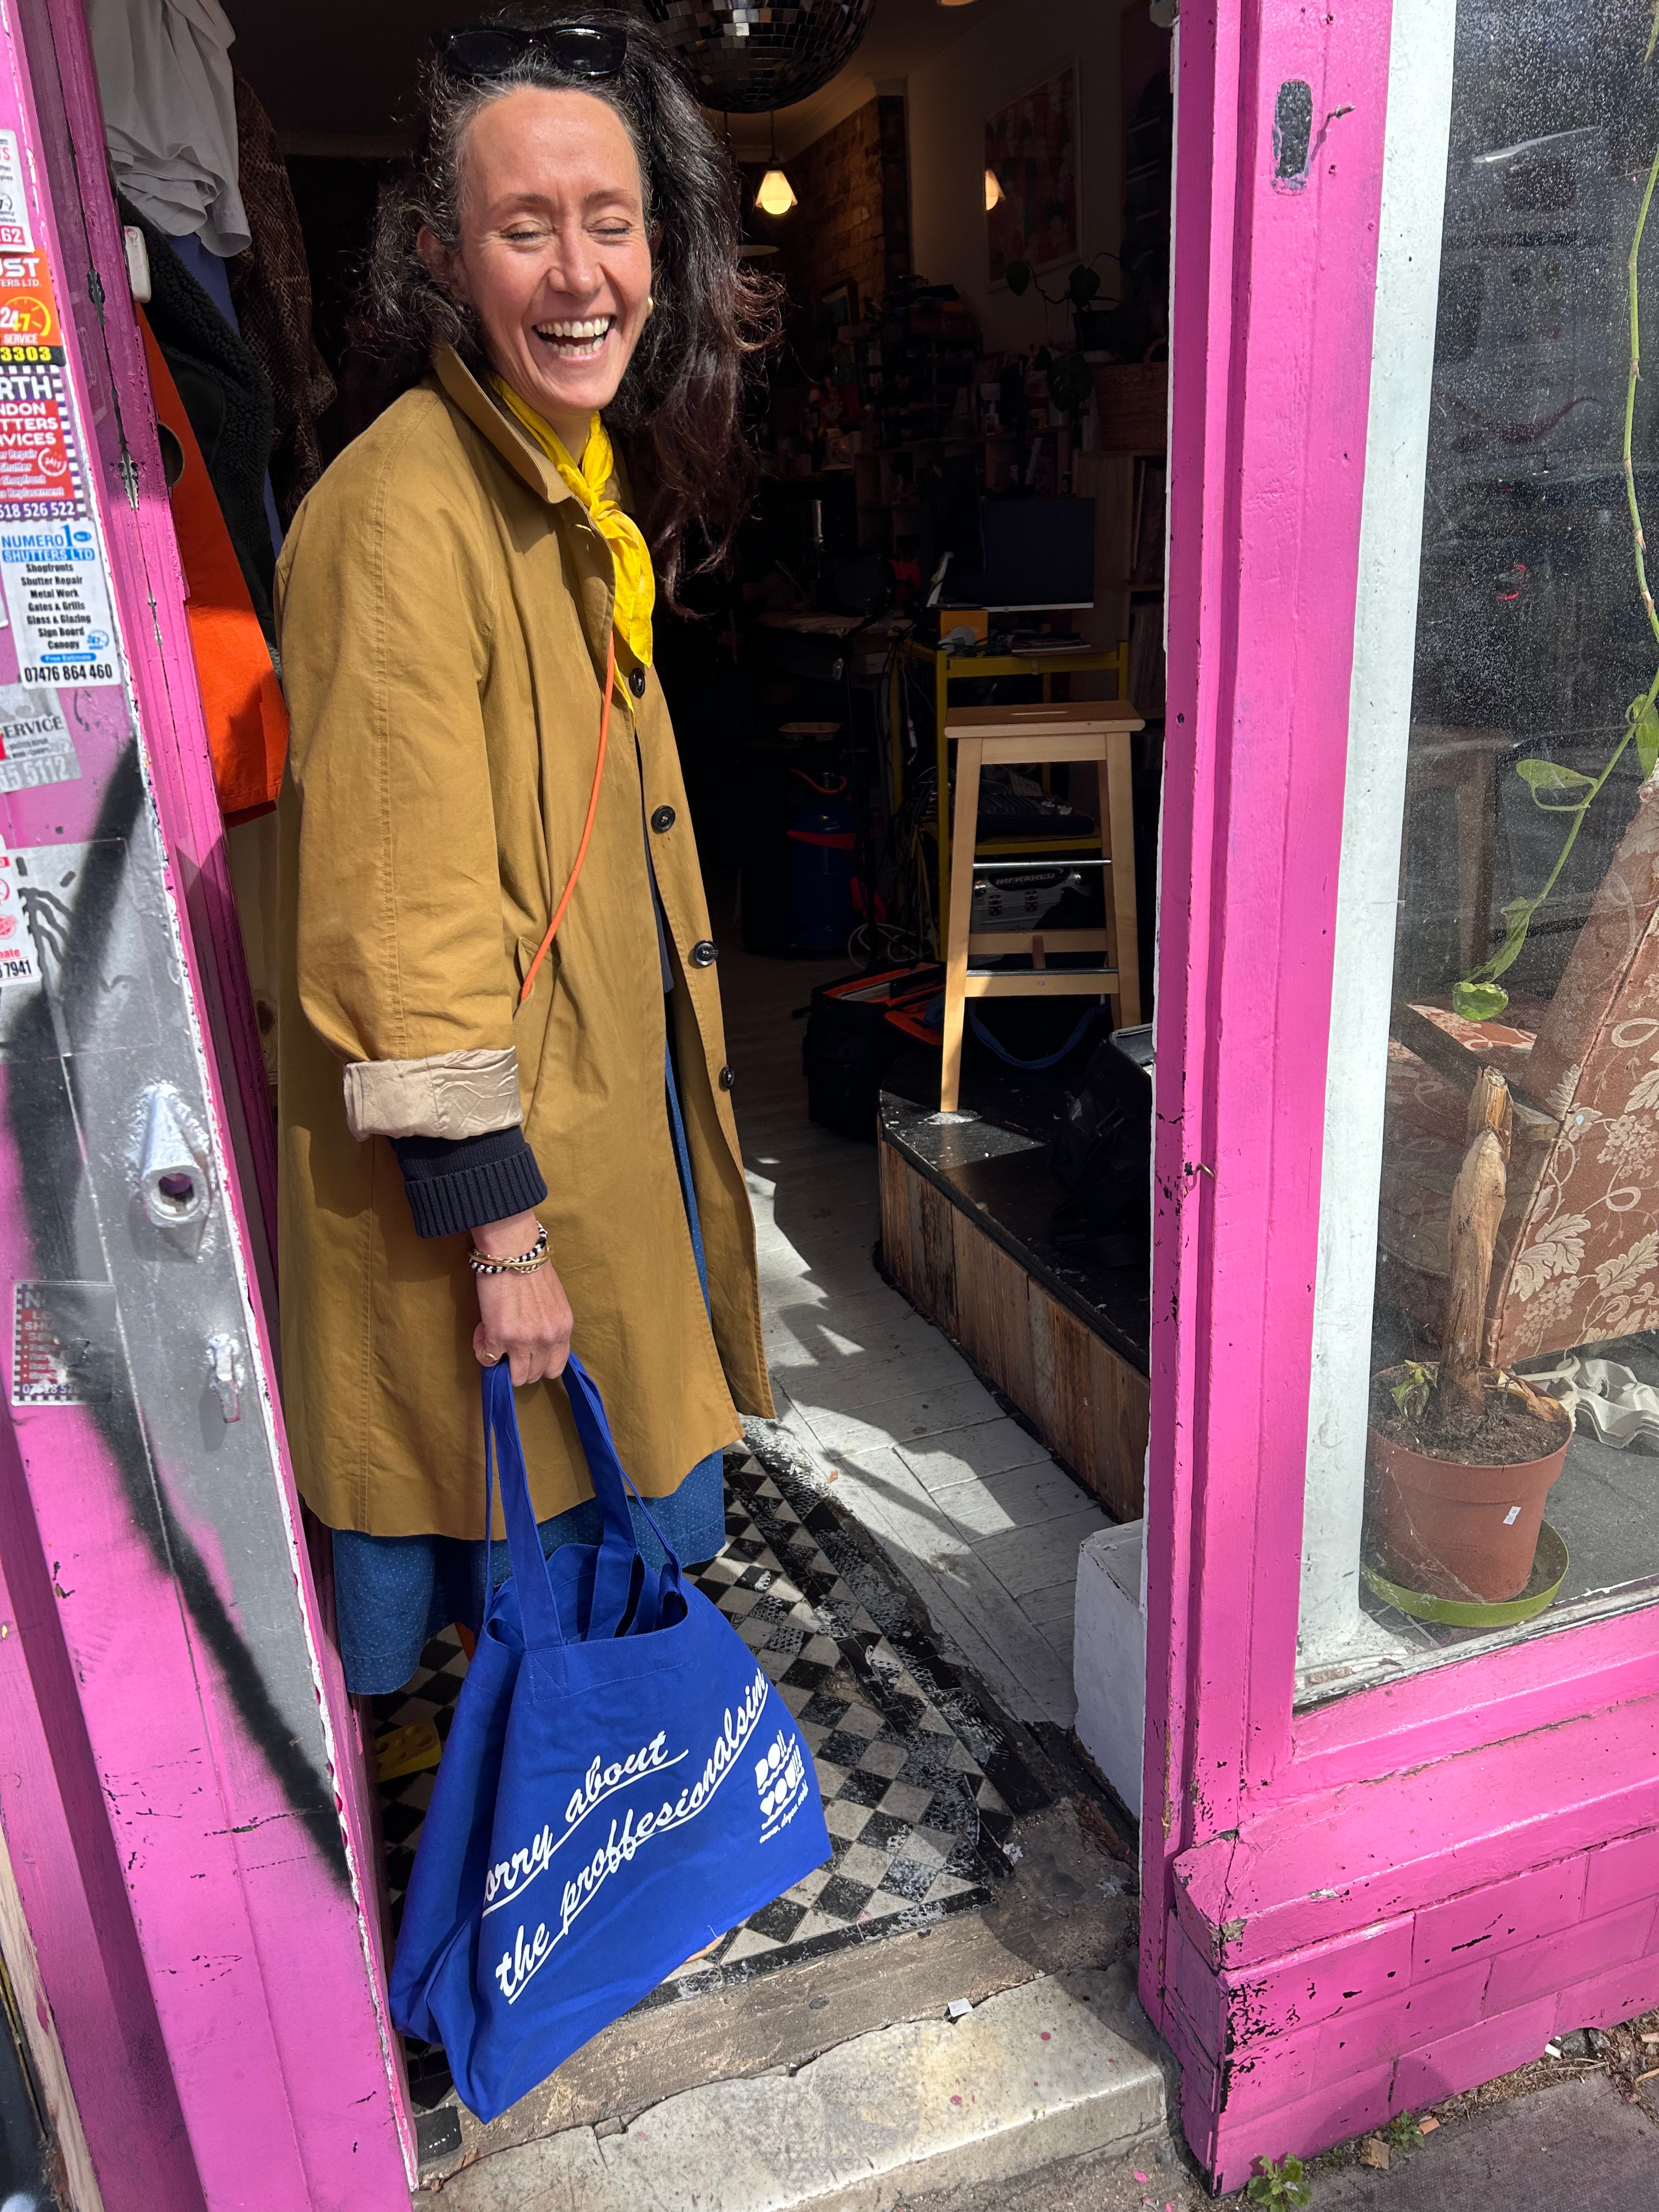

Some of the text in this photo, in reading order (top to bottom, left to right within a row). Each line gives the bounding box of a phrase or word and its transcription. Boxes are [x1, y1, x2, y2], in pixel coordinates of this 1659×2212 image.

[0, 146, 10, 160] S
[0, 258, 40, 278] ST
[0, 279, 20, 287] ERS
[4, 333, 38, 345] SERVICE
[0, 346, 52, 362] 3303
[0, 375, 52, 400] RTH
[8, 449, 37, 460] Repair
[23, 501, 48, 517] 526
[50, 501, 75, 516] 522
[1, 534, 64, 548] NUMERO
[4, 549, 94, 562] SHUTTERS LTD
[26, 563, 74, 573] Shopfronts
[21, 575, 83, 586] Shutter Repair
[30, 589, 80, 599] Metal Work
[28, 602, 53, 612] Gates
[62, 601, 86, 611] Grills
[26, 614, 51, 625] Glass
[60, 613, 92, 624] Glazing
[38, 626, 85, 637] Sign Board
[48, 640, 80, 650] Canopy
[24, 663, 112, 682] 07476 864 460
[2, 715, 65, 739] ERVICE
[483, 1825, 554, 1906] orry
[565, 1730, 669, 1822] about
[495, 1922, 550, 1997] the
